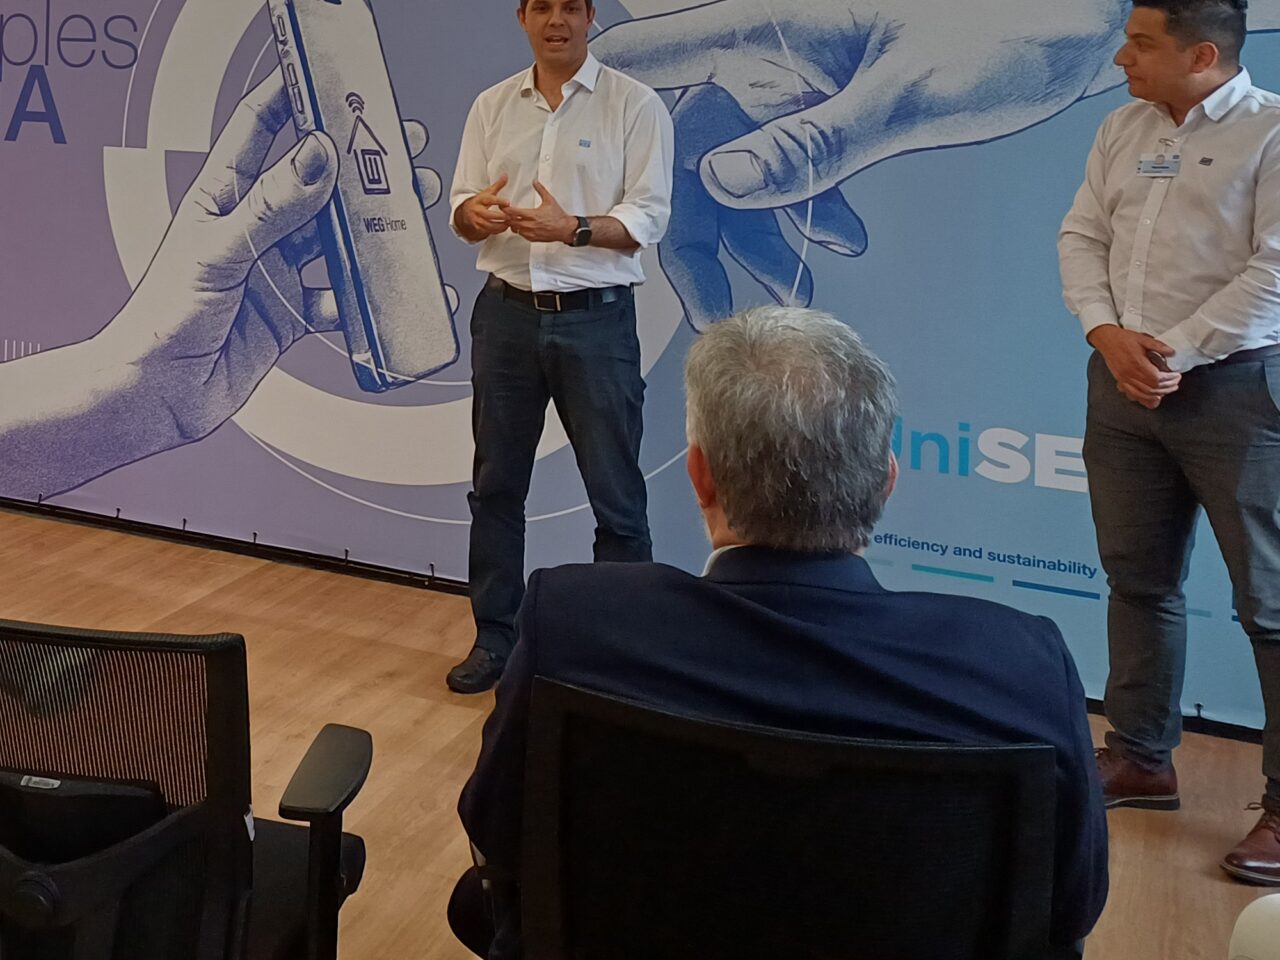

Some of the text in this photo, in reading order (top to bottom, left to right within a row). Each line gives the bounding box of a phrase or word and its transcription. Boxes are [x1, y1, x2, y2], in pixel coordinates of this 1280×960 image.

[363, 216, 407, 233] WEG Home
[873, 533, 1098, 579] efficiency and sustainability
